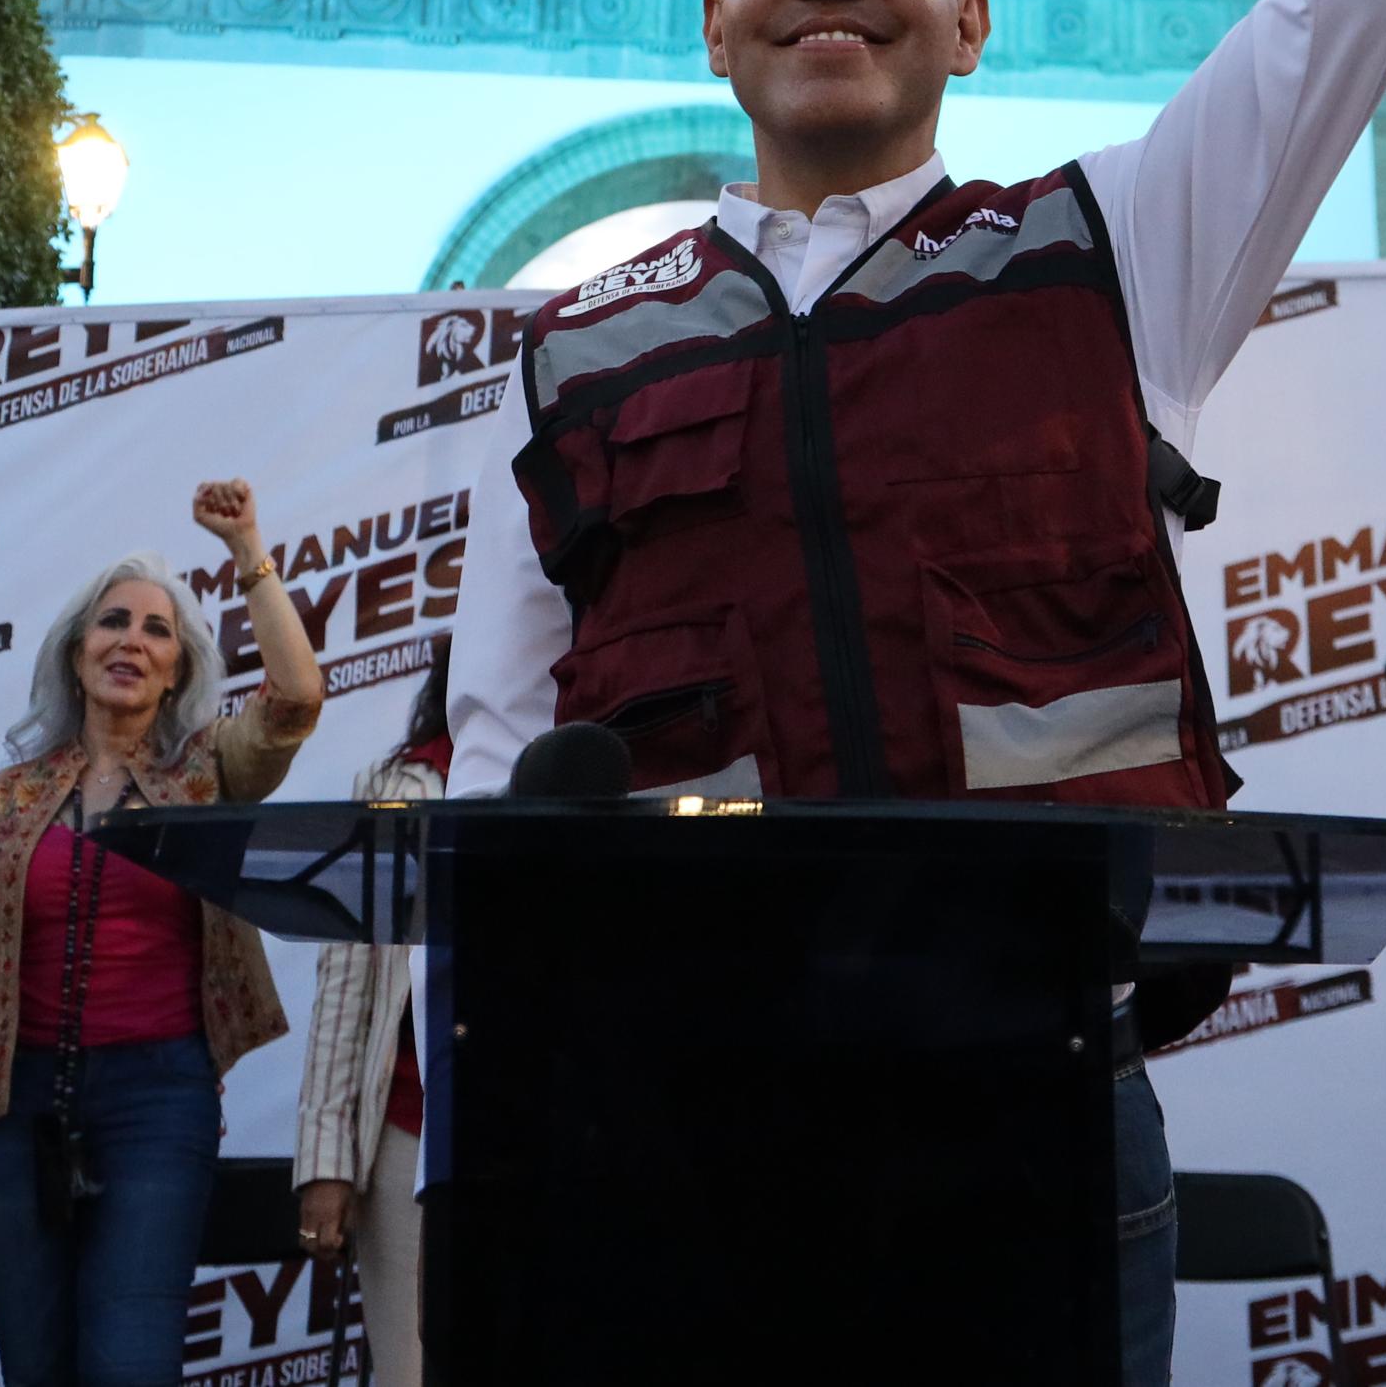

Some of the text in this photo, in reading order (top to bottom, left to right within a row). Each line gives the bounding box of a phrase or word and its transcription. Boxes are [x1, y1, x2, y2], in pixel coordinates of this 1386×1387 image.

[578, 244, 694, 301] REYES
[58, 380, 82, 407] DE
[84, 372, 108, 399] LA
[110, 338, 209, 389] SOBERANÍA
[226, 328, 276, 355] NACIONAL
[393, 381, 508, 437] POR LA DEFE
[328, 639, 434, 690] SOBERANÍA
[1281, 680, 1376, 735] DEFENSA
